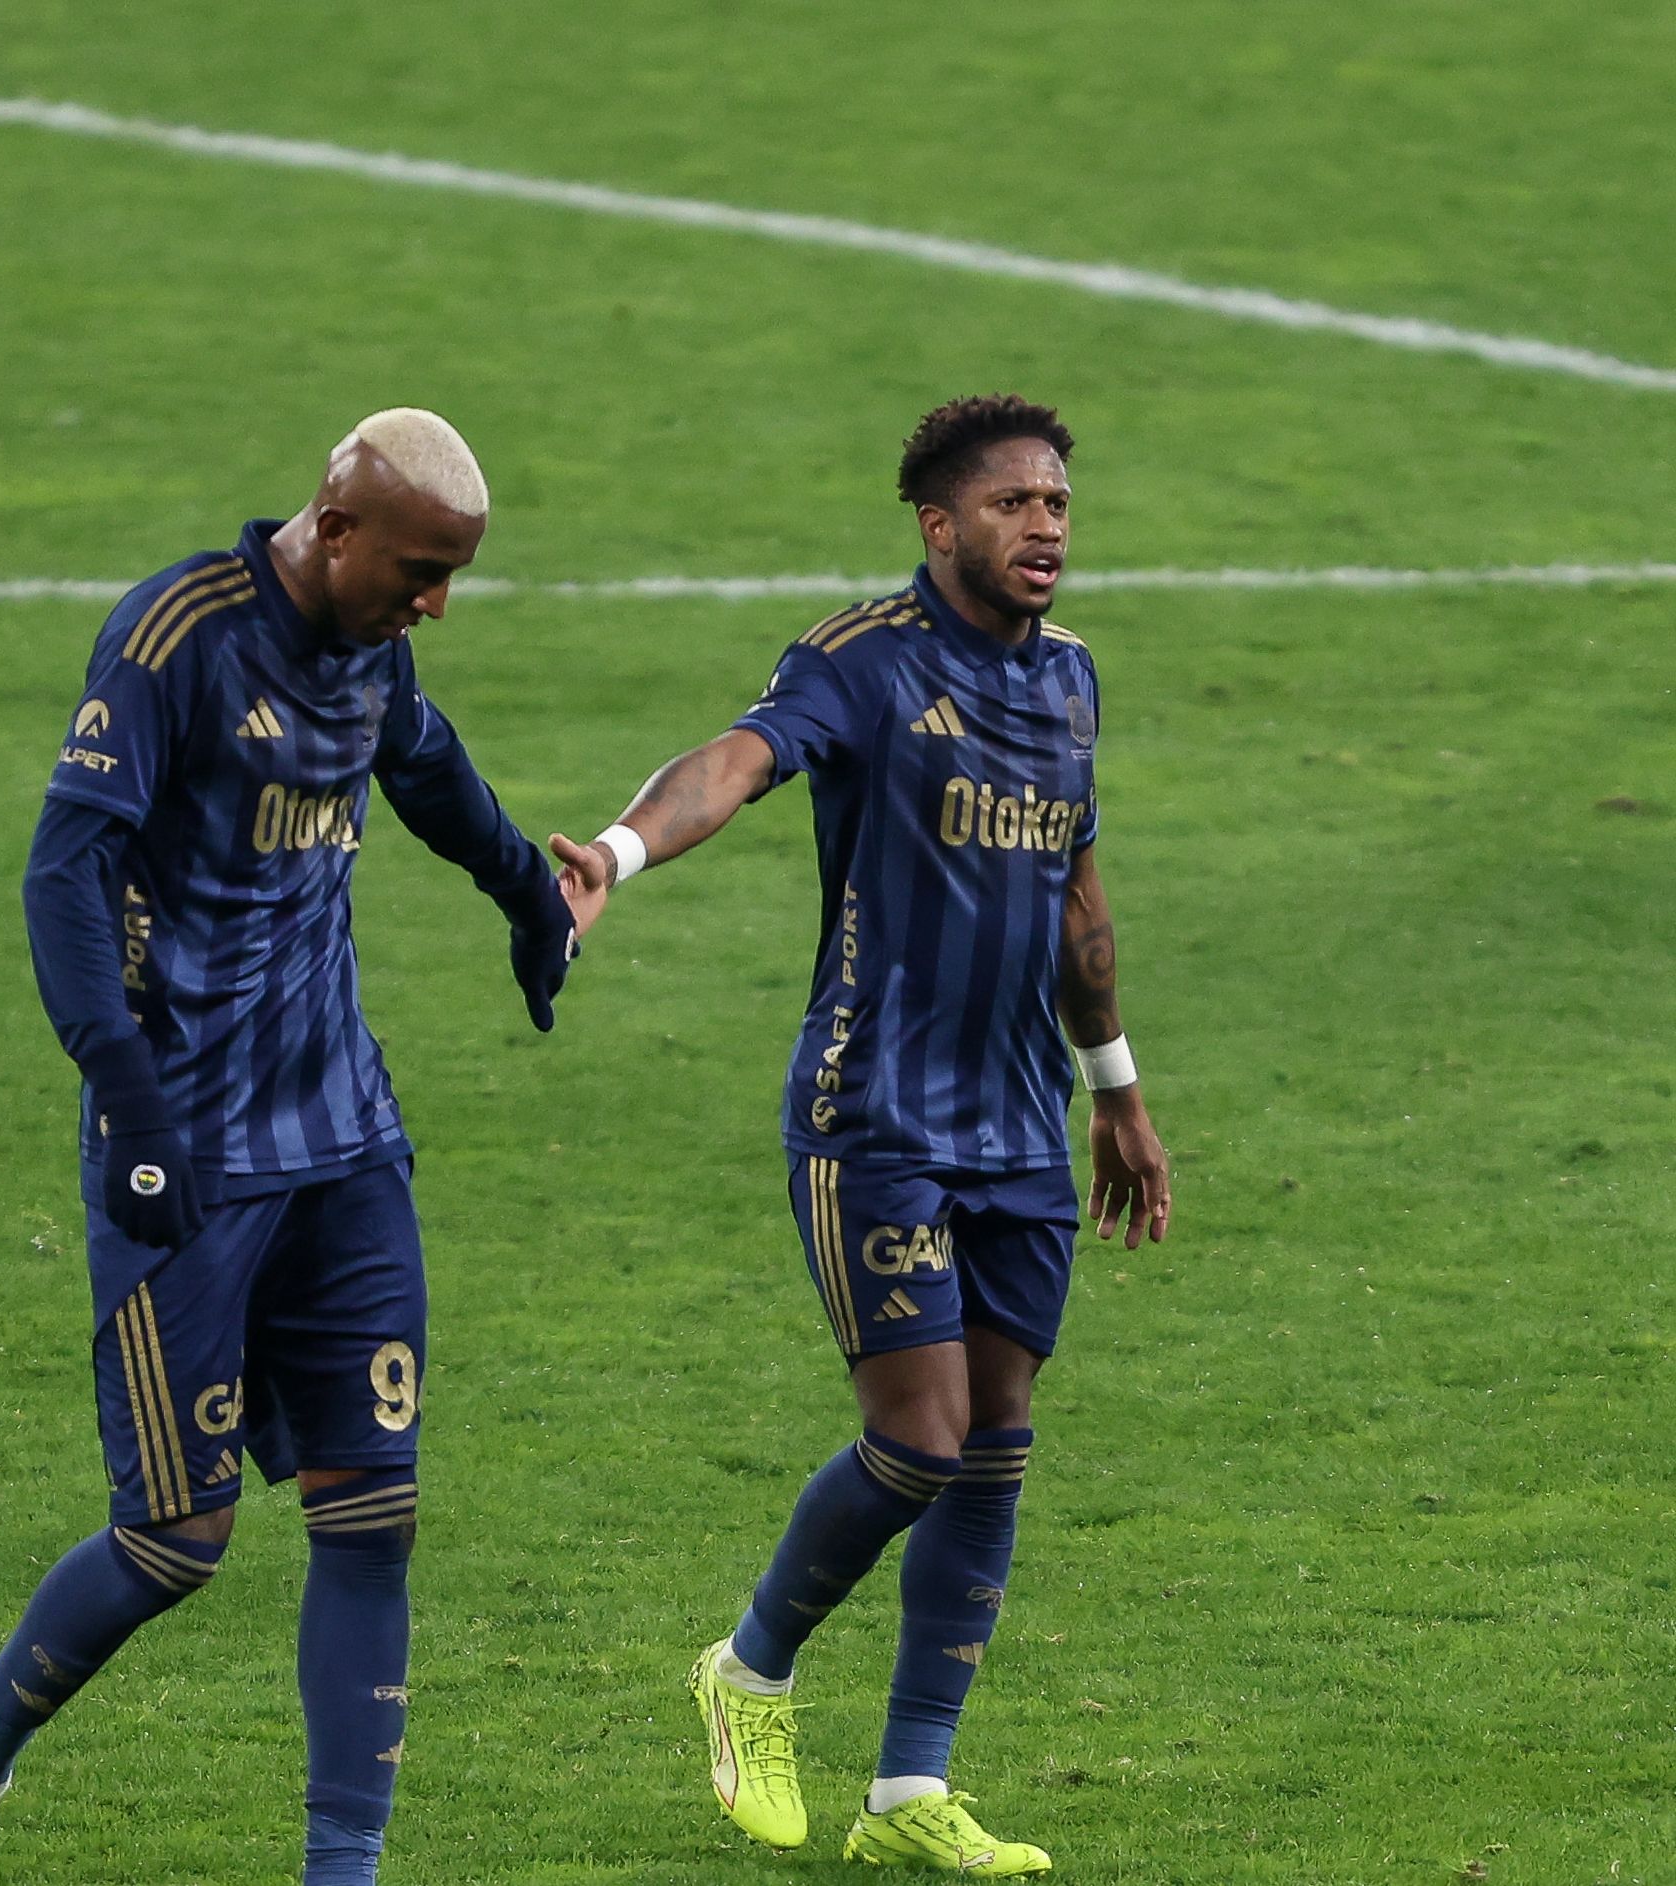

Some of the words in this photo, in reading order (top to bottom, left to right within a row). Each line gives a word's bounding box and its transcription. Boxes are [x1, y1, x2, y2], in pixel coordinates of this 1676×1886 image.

[816, 1005, 854, 1093] SAFI
[841, 880, 859, 987] PORT
[370, 1340, 417, 1432] 9
